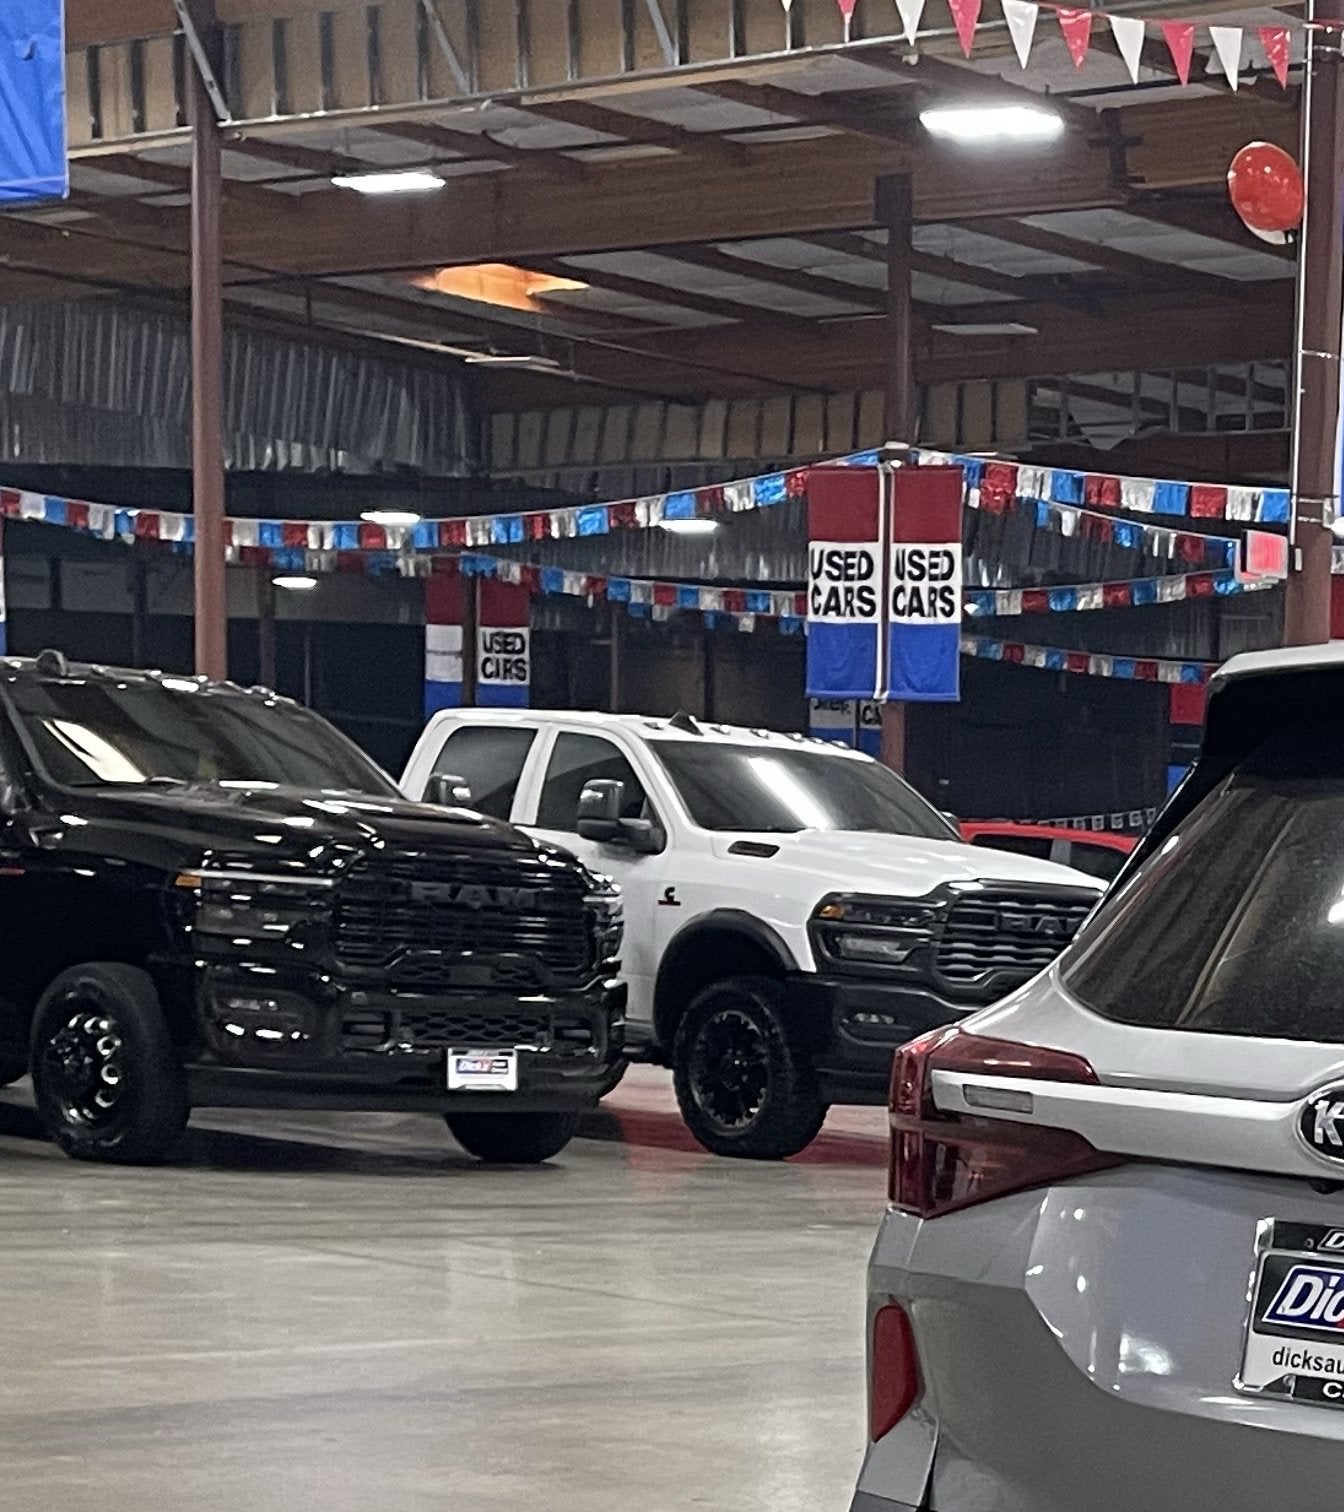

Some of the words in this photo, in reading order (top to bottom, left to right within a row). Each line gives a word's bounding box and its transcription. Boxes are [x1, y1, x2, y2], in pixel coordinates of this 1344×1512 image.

[811, 548, 874, 582] USED
[895, 549, 955, 582] USED
[811, 583, 877, 618] CARS
[892, 585, 955, 618] CARS
[482, 630, 526, 655] USED
